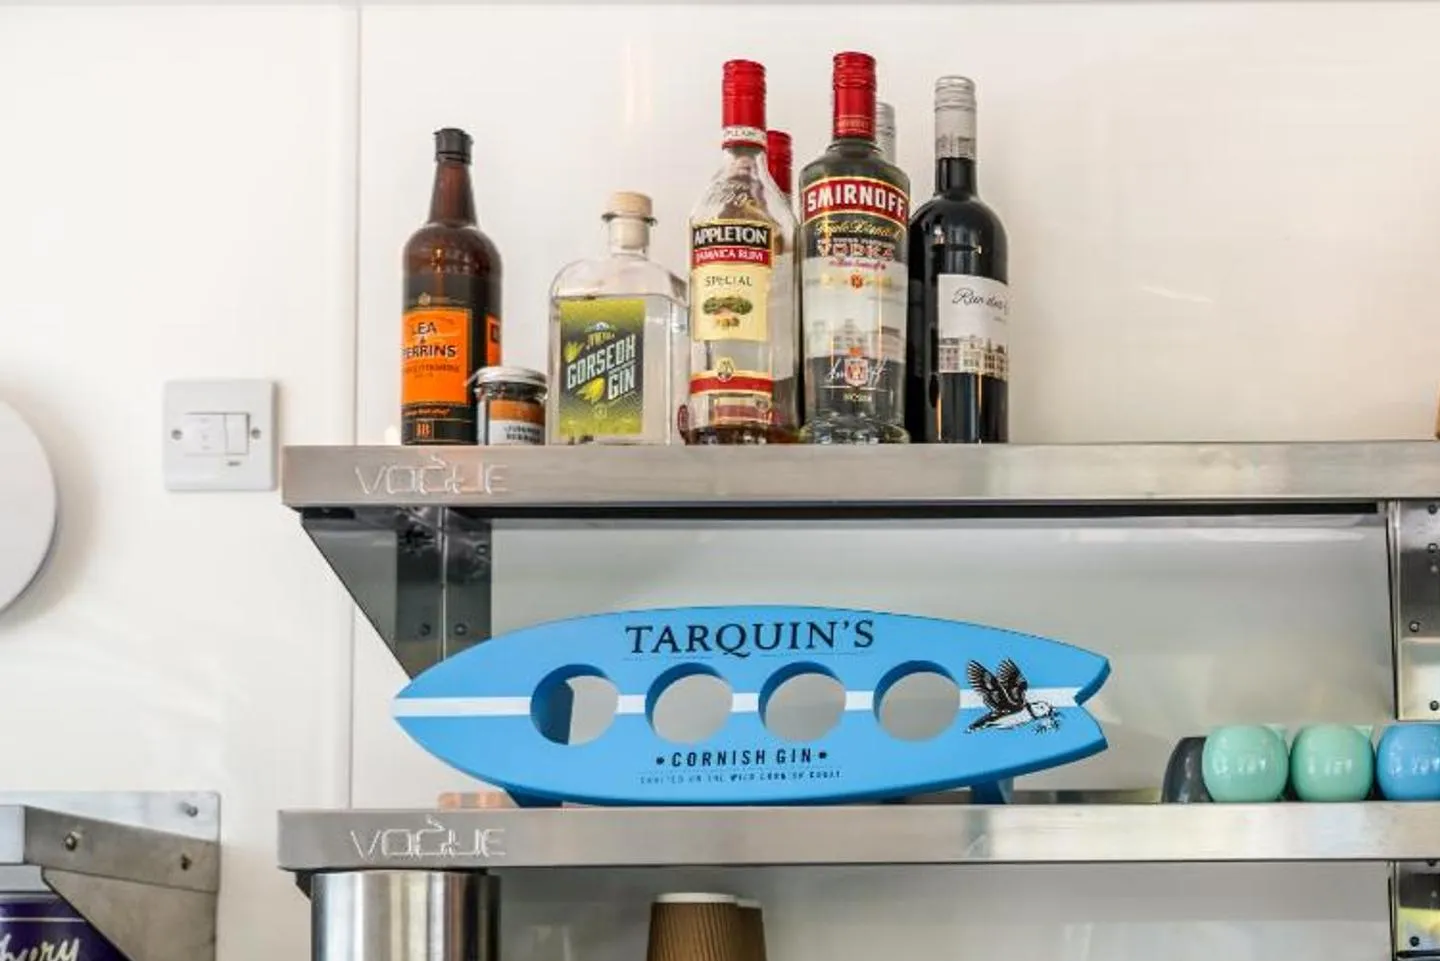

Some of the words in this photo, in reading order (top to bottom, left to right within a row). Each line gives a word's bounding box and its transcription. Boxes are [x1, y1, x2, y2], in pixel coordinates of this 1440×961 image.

[807, 183, 905, 218] SMIRNOFF
[694, 226, 767, 245] APPLETON
[608, 365, 635, 400] GIN
[625, 620, 874, 657] TARQUIN'S
[672, 750, 765, 767] CORNISH
[776, 748, 811, 763] GIN
